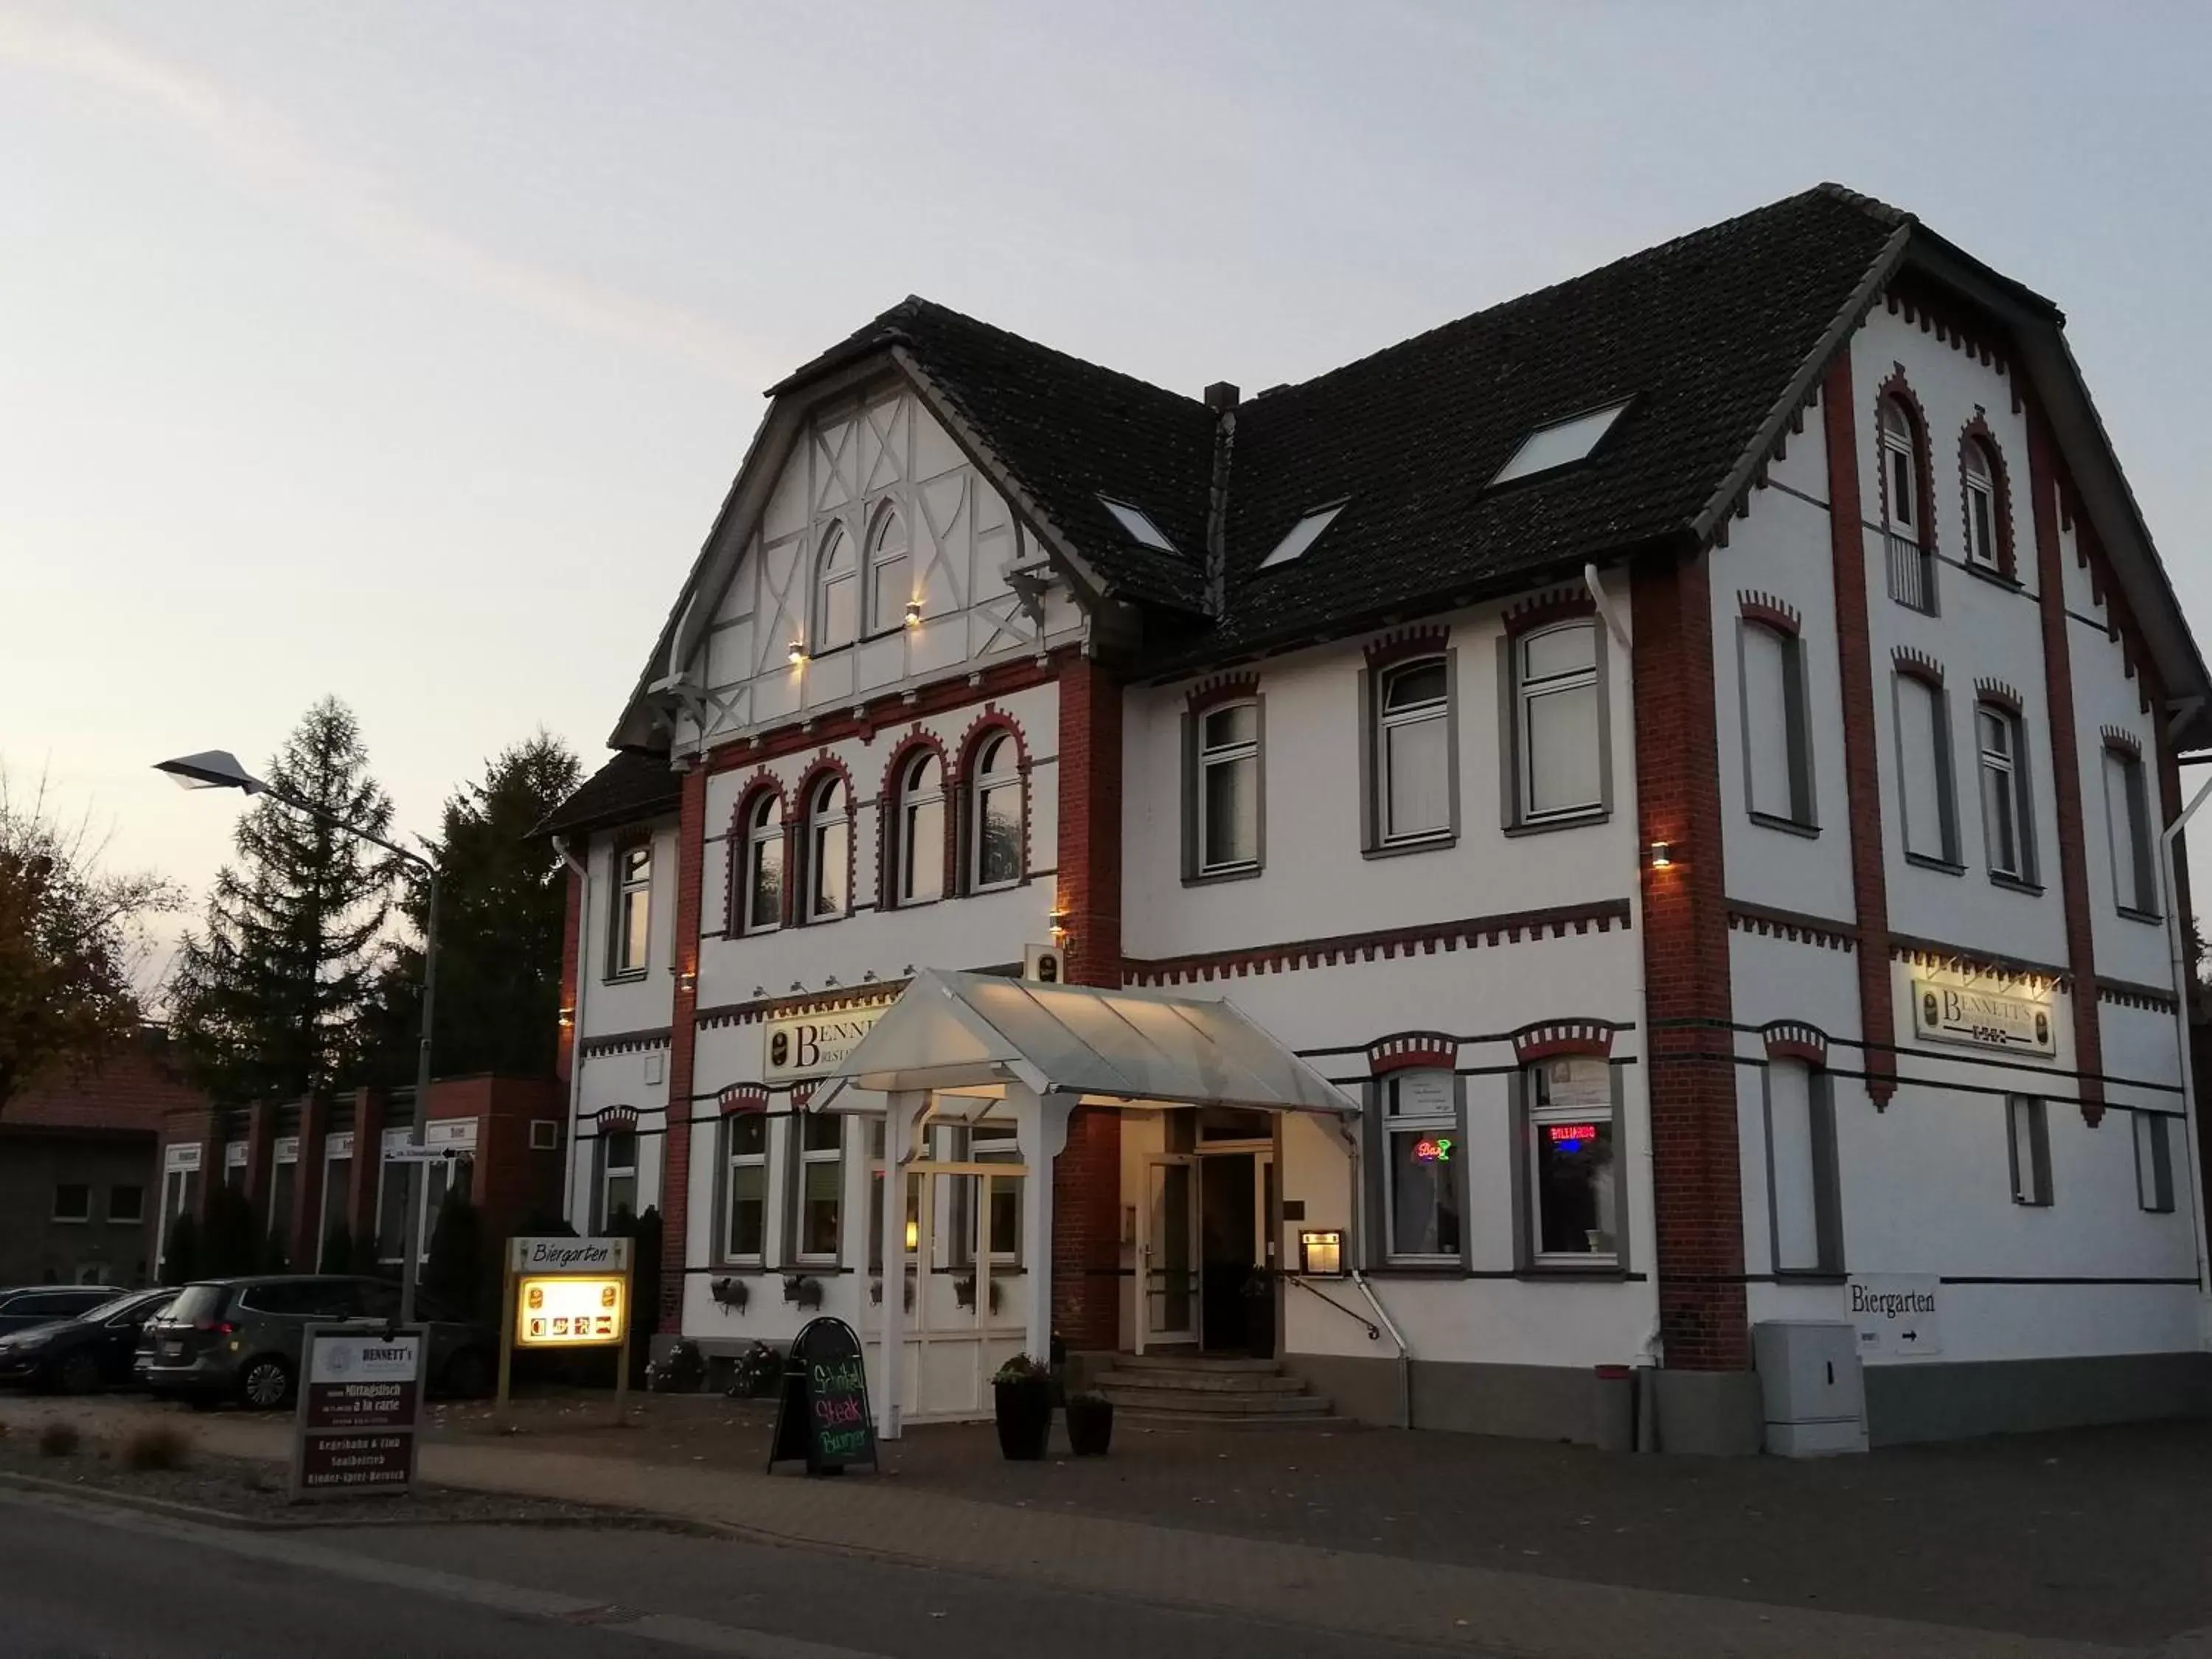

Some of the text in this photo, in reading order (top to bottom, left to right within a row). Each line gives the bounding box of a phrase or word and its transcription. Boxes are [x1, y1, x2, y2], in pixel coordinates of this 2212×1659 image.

[533, 1244, 608, 1267] Biergarten
[1851, 1284, 1935, 1318] Biergarten
[346, 1383, 401, 1397] Mittagstisch
[375, 1399, 400, 1411] carte
[815, 1394, 862, 1427] Steak
[819, 1430, 866, 1453] Burger
